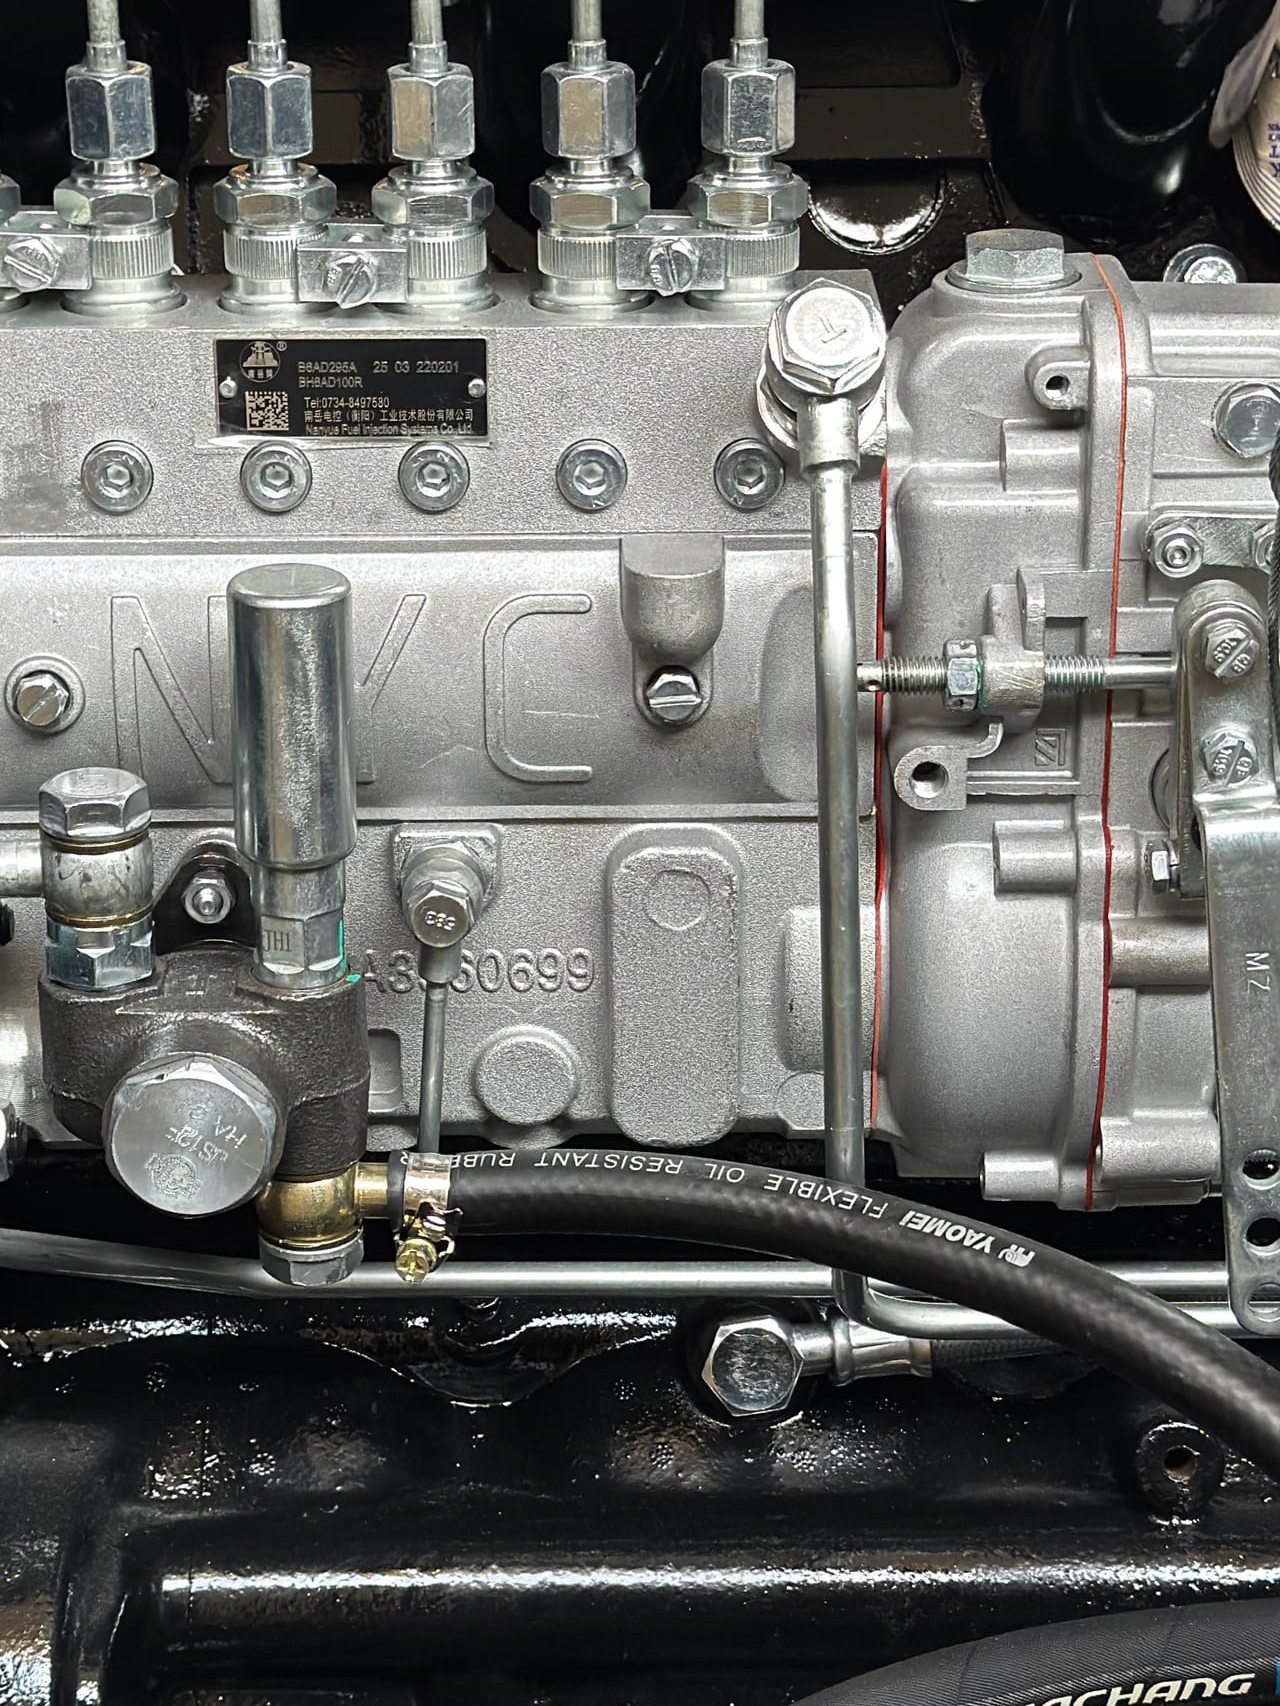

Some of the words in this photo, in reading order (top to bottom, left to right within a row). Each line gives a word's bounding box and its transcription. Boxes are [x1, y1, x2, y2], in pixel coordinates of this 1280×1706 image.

[372, 361, 388, 373] 25
[394, 361, 409, 373] 03
[416, 361, 459, 373] 220201
[361, 424, 399, 435] Injection
[534, 1151, 684, 1174] RESISTANT
[704, 1161, 746, 1184] OIL
[764, 1172, 888, 1219] FLEXIBLE
[899, 1209, 996, 1255] YAOMEI
